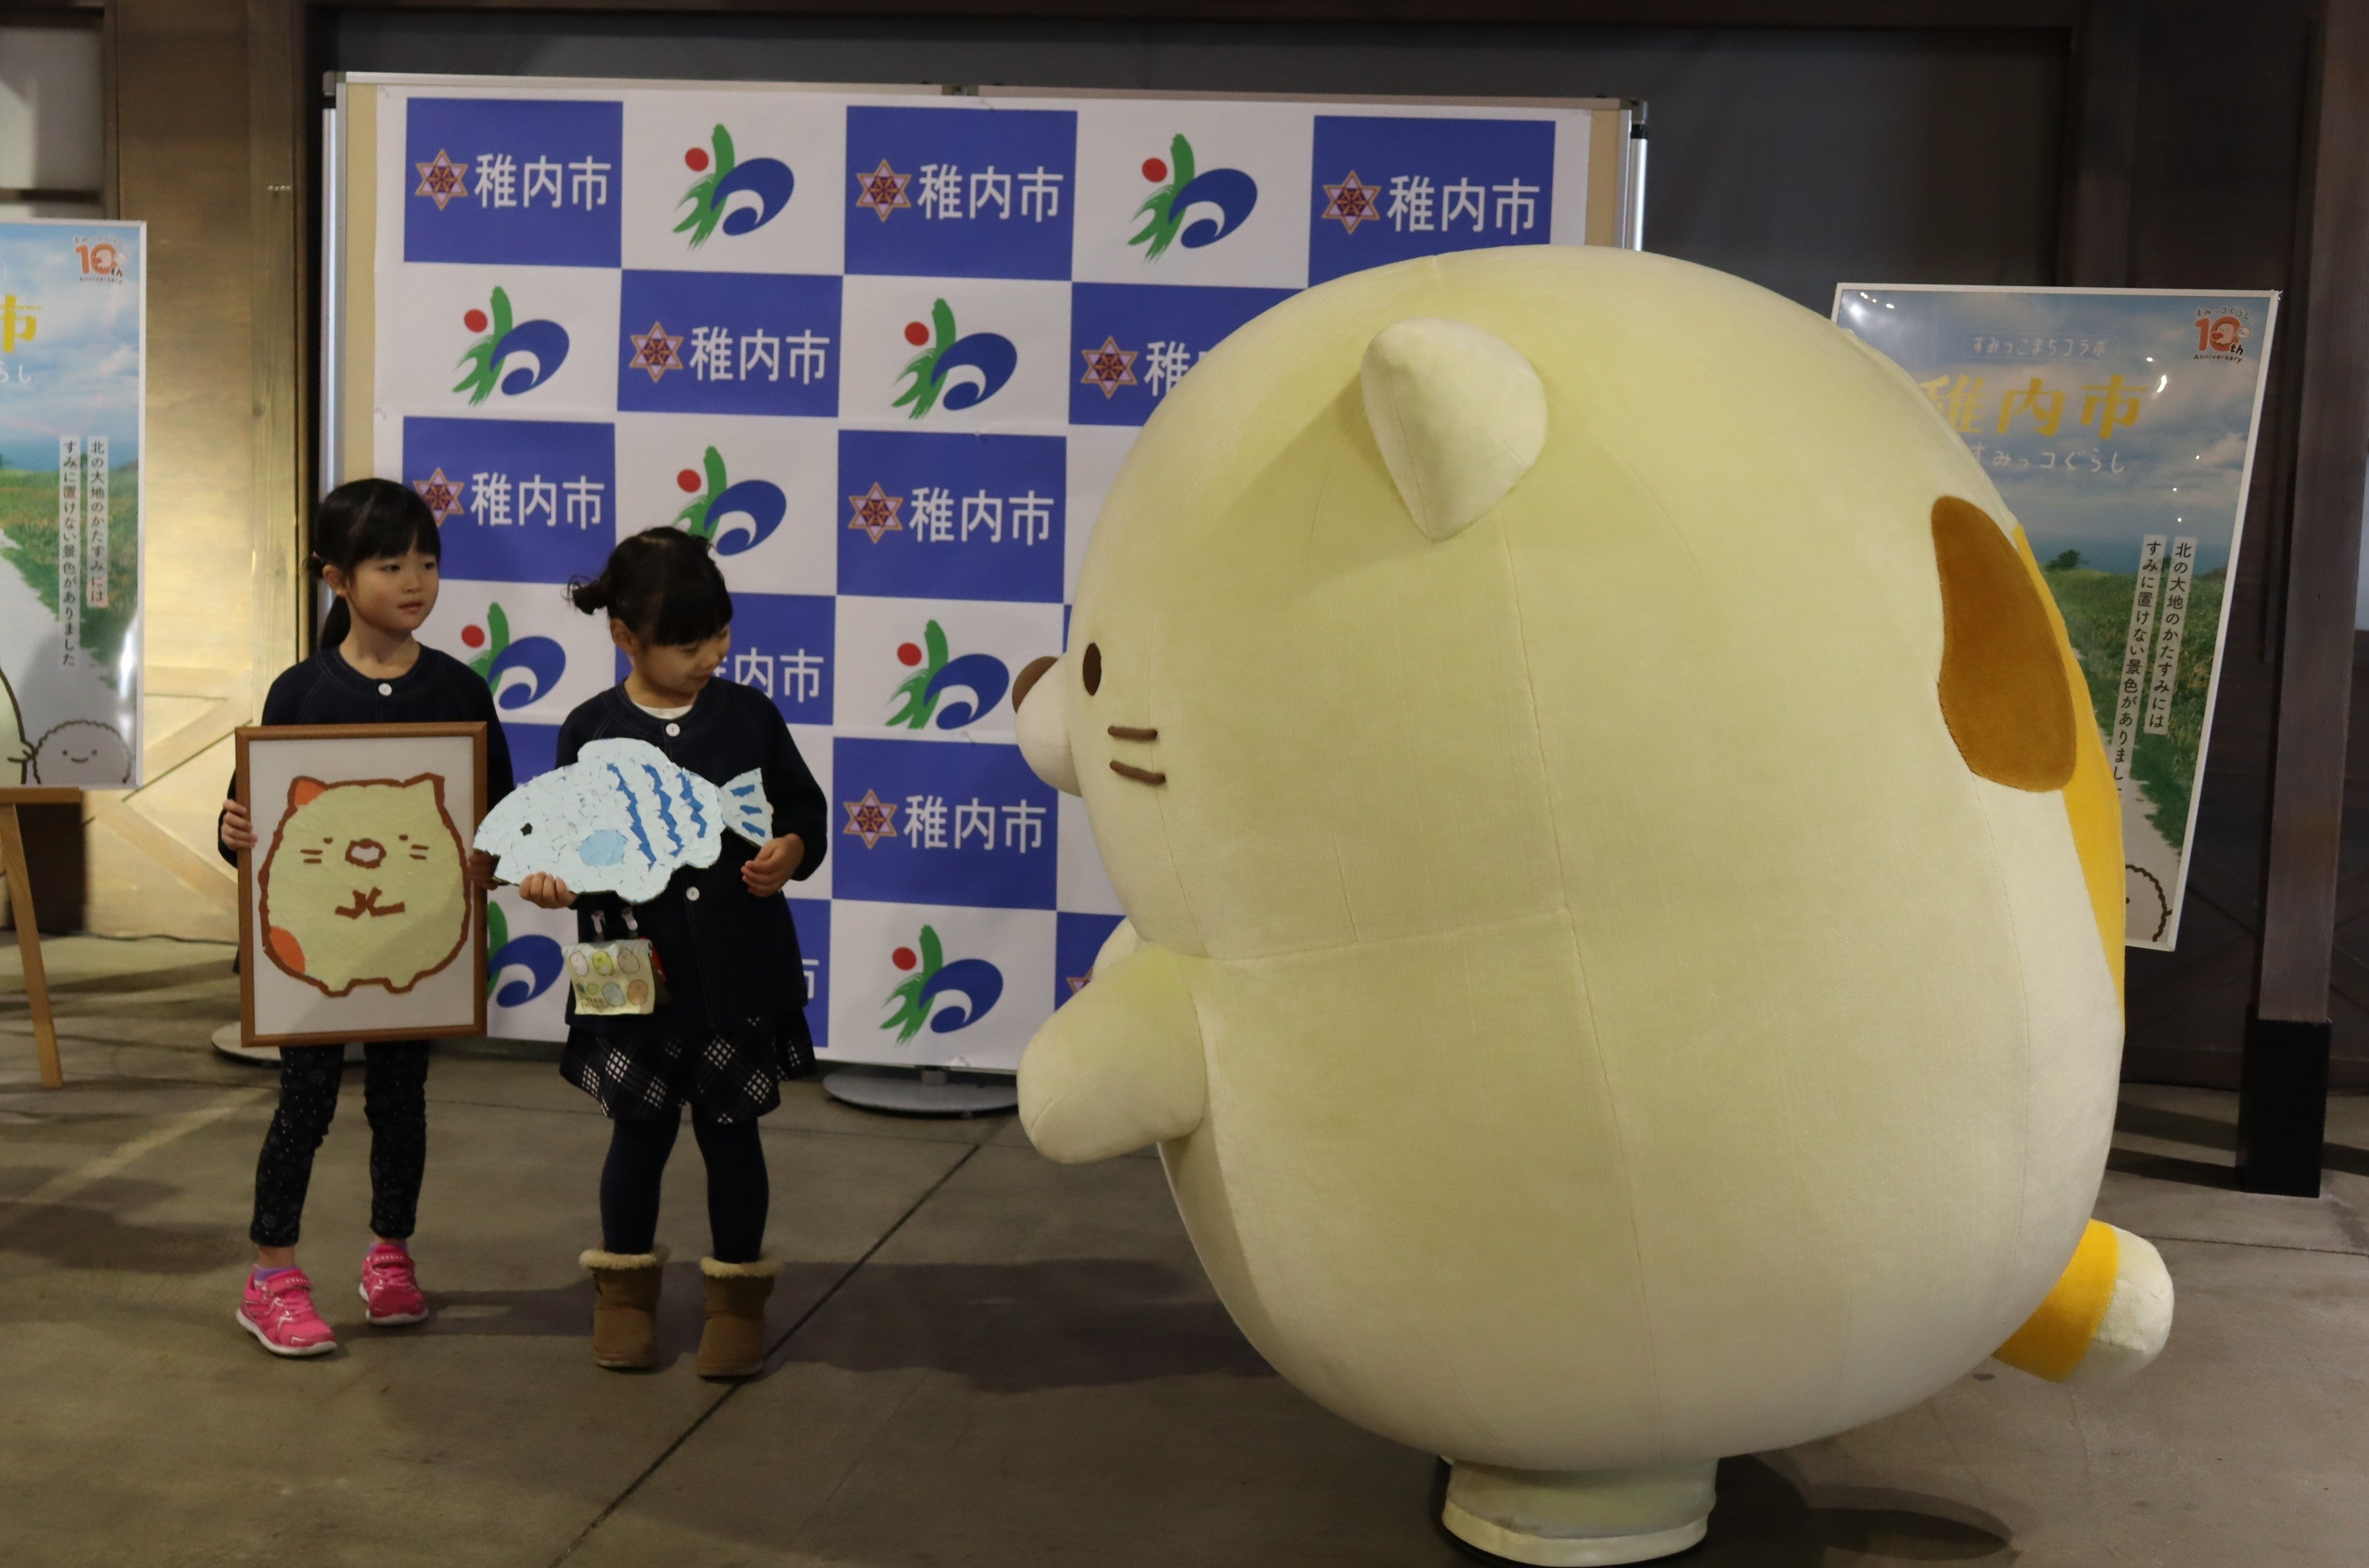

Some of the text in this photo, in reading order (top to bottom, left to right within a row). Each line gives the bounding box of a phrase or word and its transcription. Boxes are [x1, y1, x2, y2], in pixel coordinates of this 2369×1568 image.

[475, 153, 611, 210] 稚内市
[918, 163, 1063, 222] 稚内市
[1388, 175, 1540, 235] 稚内市
[690, 326, 830, 384] 稚内市
[2194, 353, 2243, 363] Anniversary
[1919, 373, 2148, 440] 稚内市
[90, 440, 105, 602] 北の大地のかたすみには
[470, 471, 605, 529] 稚内市
[910, 487, 1054, 545] 稚内市
[62, 439, 77, 667] すみに置けない景色がありました
[2149, 542, 2192, 729] 北の大地のかたすみには
[714, 647, 824, 704] 内市
[903, 795, 1046, 853] 稚内市
